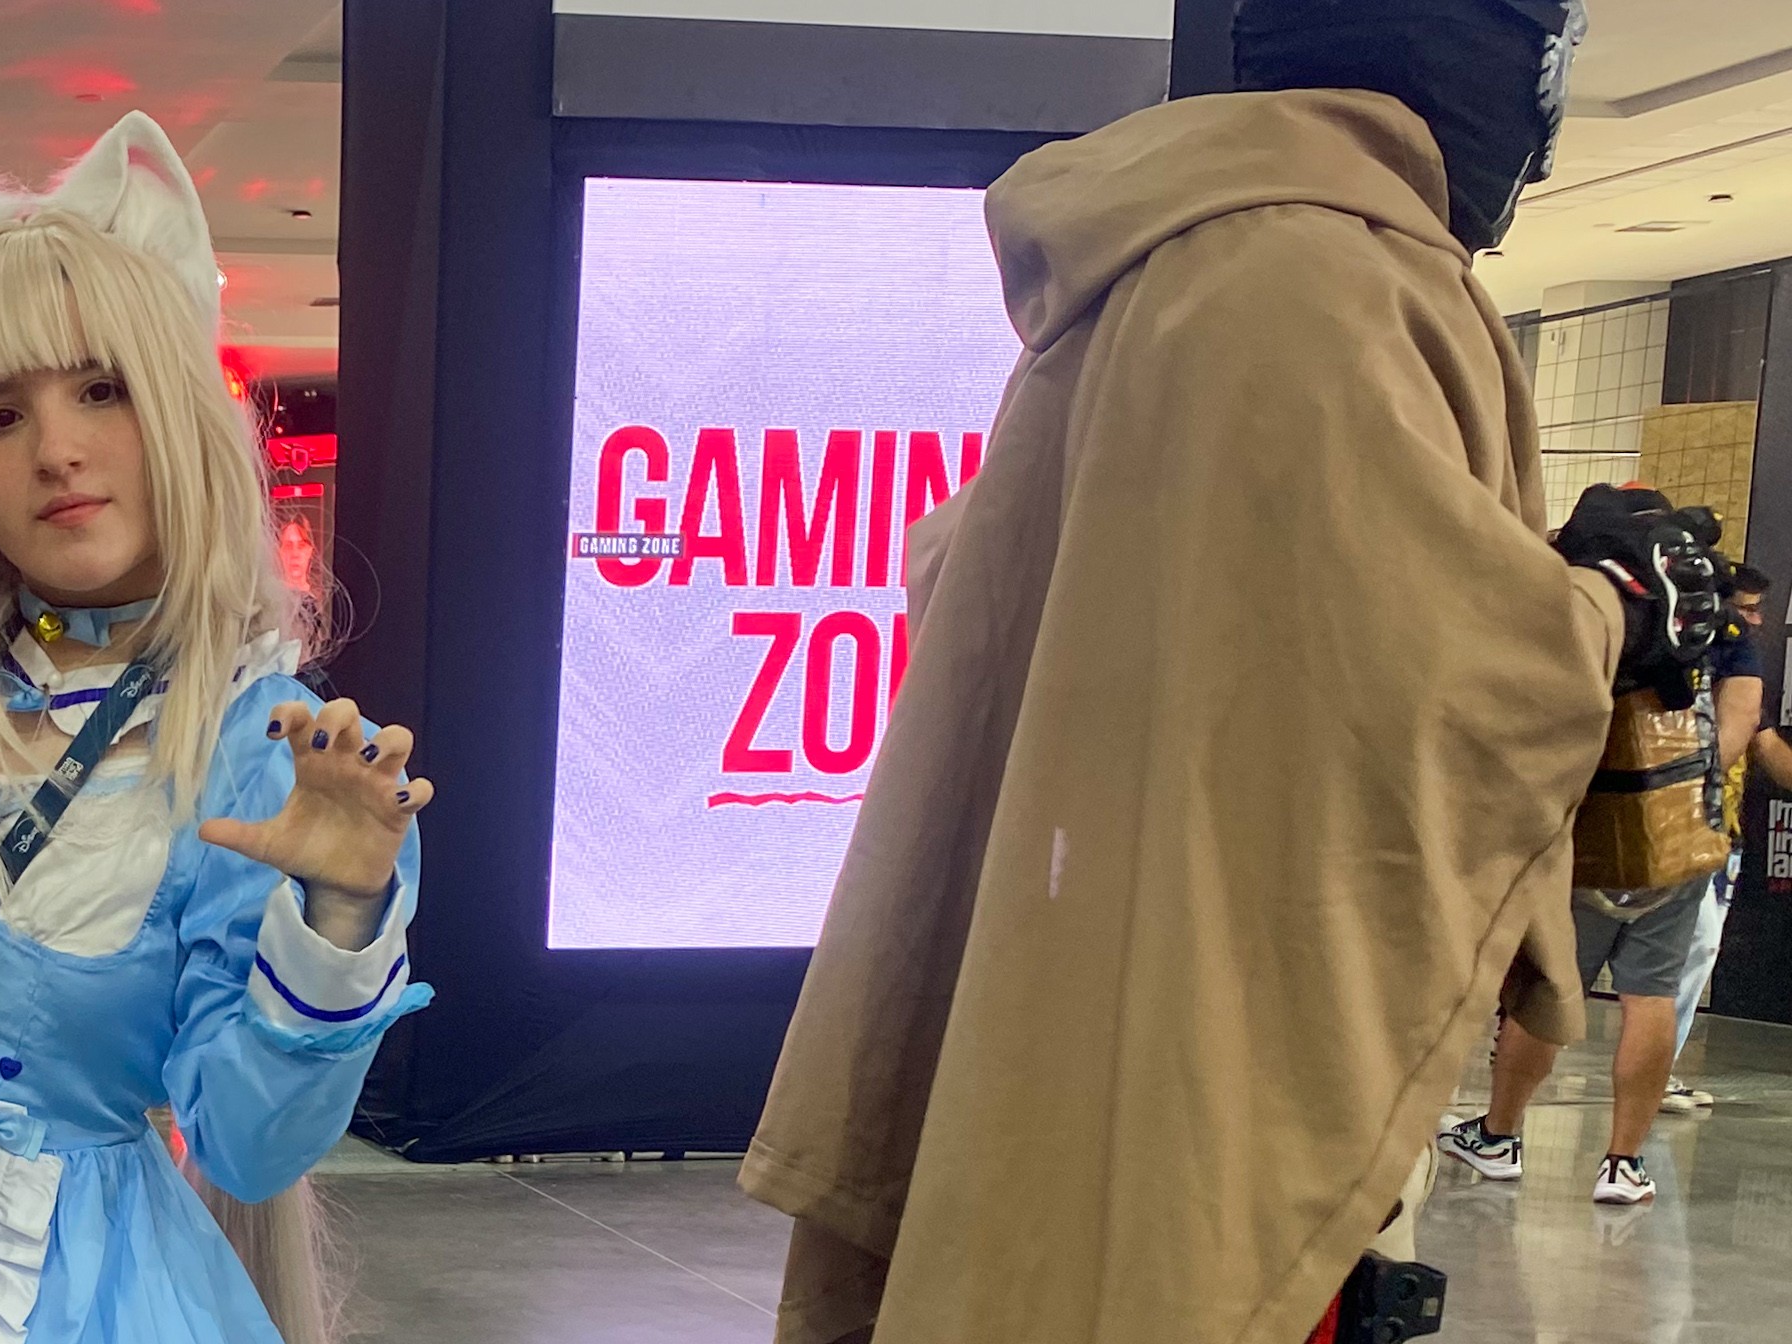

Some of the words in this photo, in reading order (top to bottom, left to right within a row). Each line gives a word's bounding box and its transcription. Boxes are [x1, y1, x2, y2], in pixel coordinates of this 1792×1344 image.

[579, 536, 638, 554] GAMING
[641, 537, 680, 554] ZONE
[594, 425, 984, 588] GAMIN
[720, 610, 908, 775] ZO
